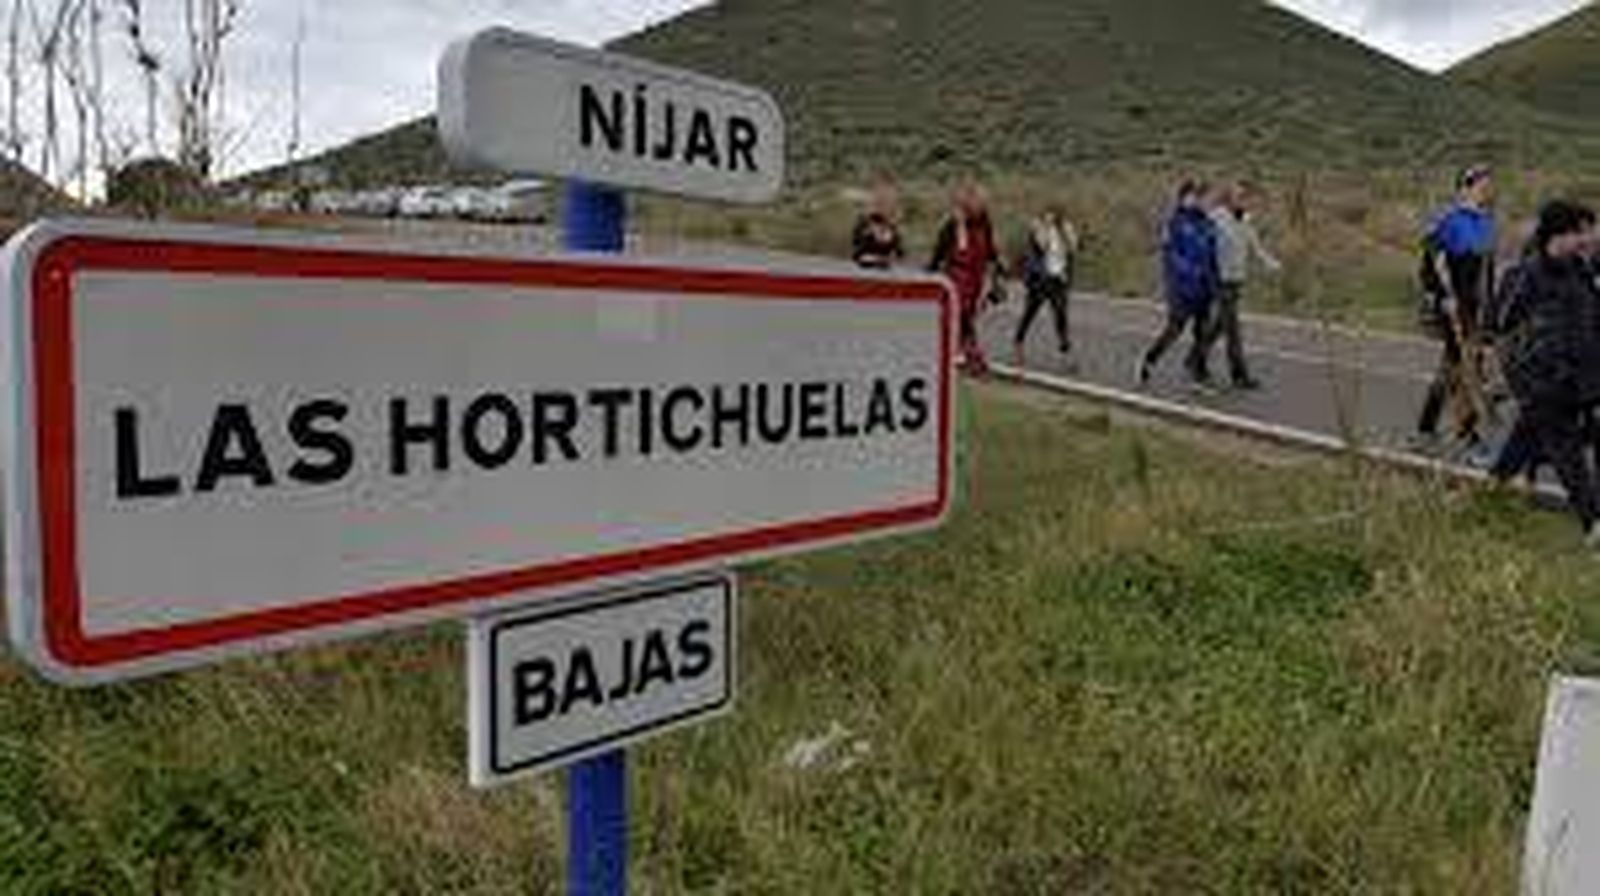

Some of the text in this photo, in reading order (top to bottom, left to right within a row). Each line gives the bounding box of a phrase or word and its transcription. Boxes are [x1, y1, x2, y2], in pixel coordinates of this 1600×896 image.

[578, 82, 760, 174] NÍJAR
[112, 377, 930, 501] LAS HORTICHUELAS
[511, 618, 715, 729] BAJAS
